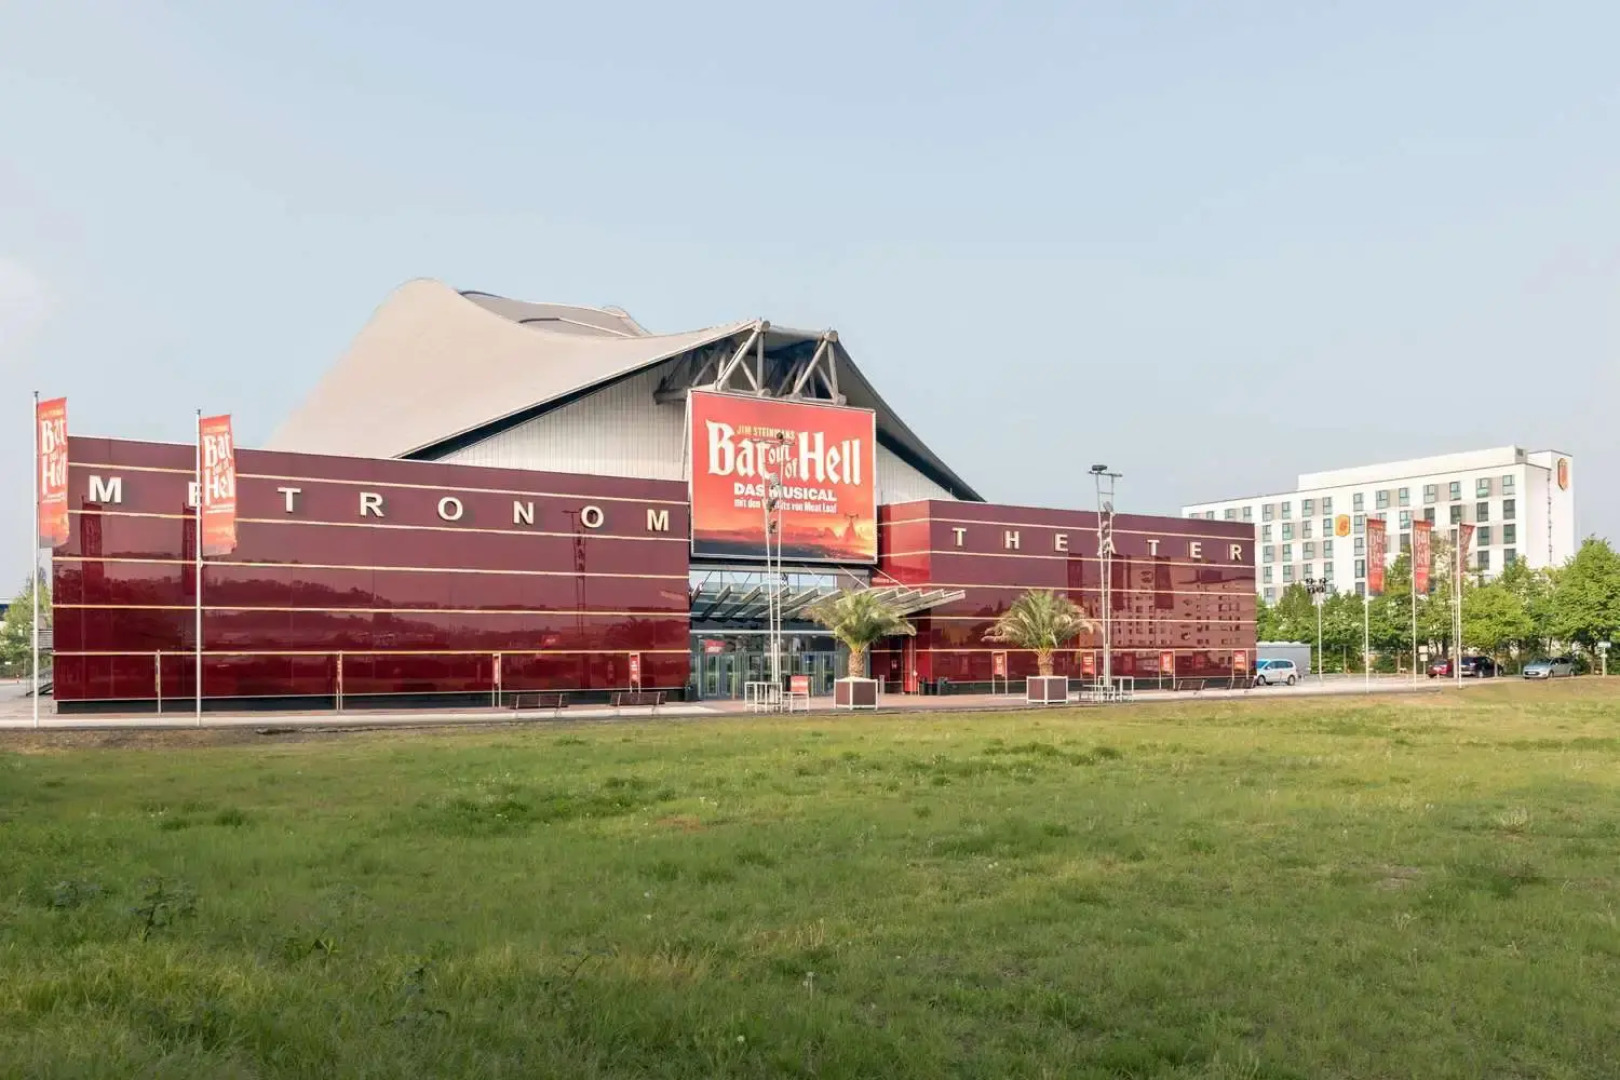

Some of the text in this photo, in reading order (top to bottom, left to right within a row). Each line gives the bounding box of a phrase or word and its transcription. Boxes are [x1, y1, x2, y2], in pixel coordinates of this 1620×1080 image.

[41, 418, 66, 455] Bat
[203, 432, 231, 468] Bat
[705, 418, 775, 480] Bat
[798, 431, 861, 486] Hell
[204, 466, 235, 506] Hell
[734, 482, 838, 502] DAS MUSICAL
[952, 527, 1243, 561] THEATER
